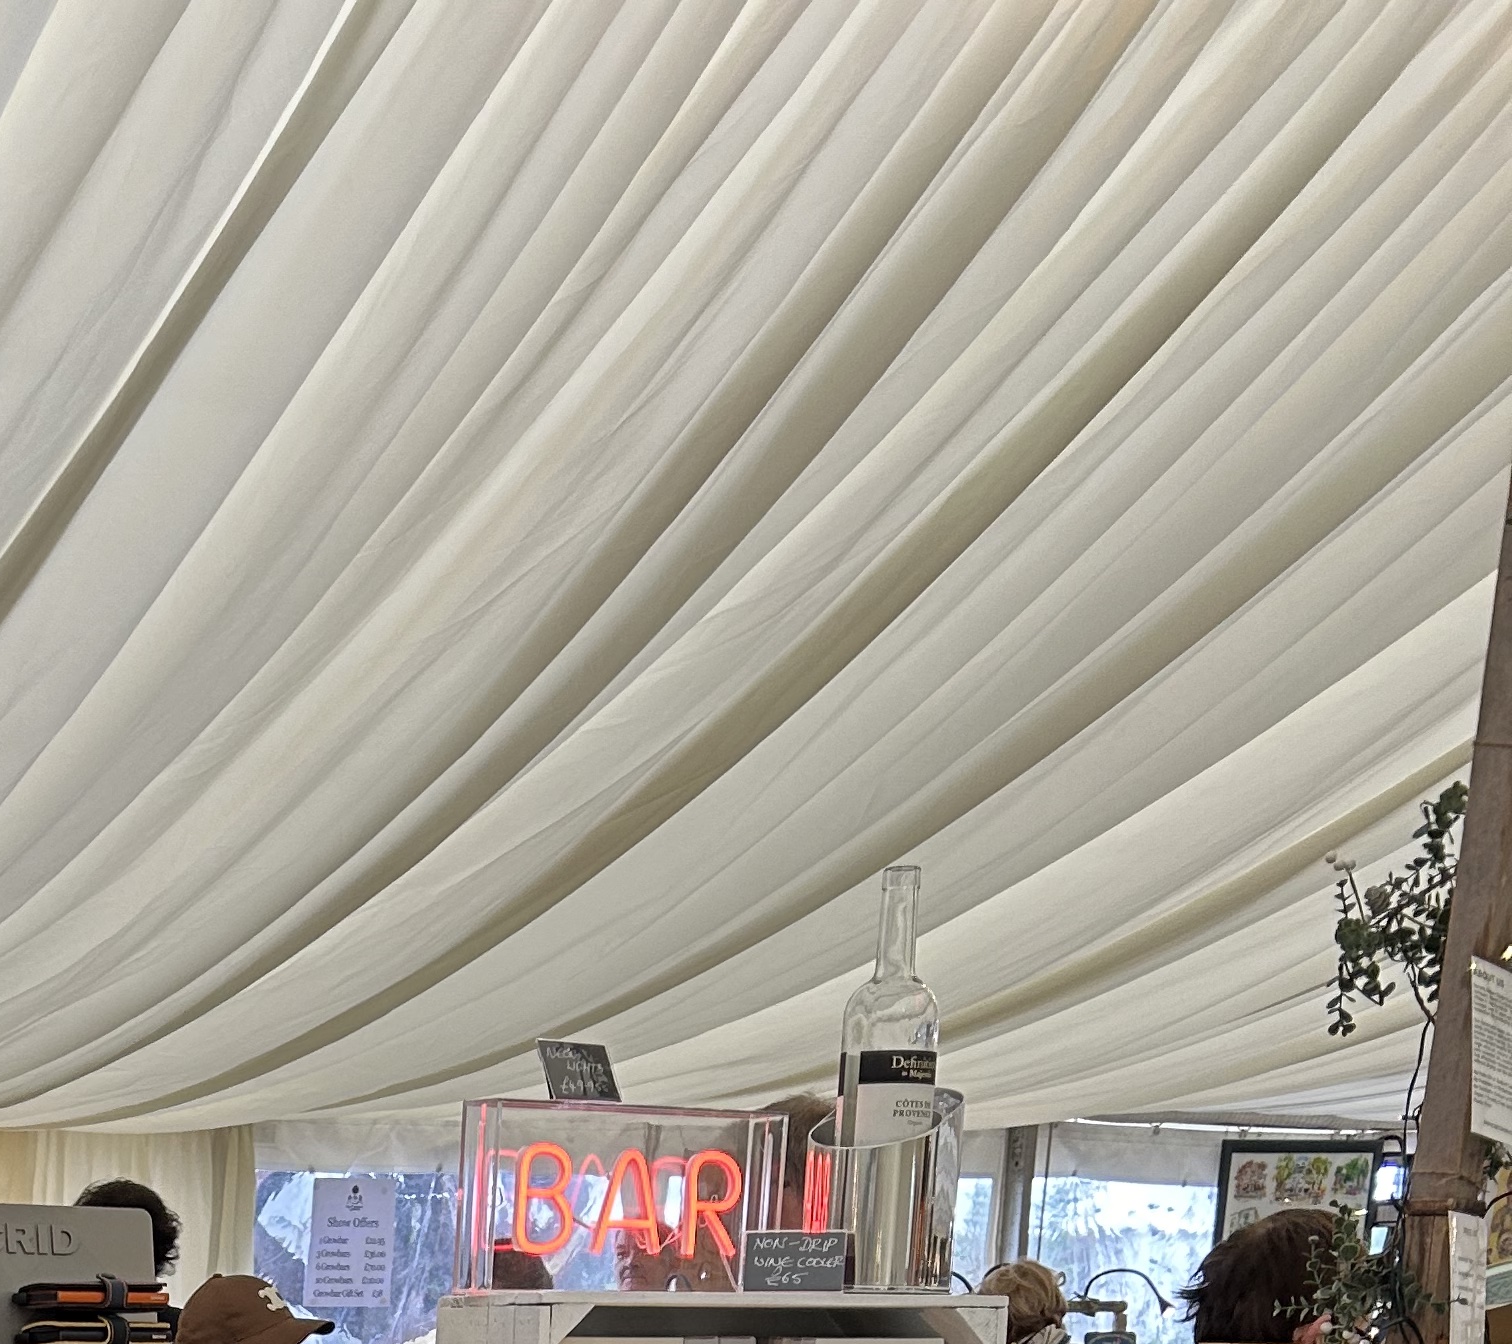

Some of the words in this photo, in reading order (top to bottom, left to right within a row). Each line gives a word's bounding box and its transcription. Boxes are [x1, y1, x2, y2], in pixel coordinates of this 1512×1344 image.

[514, 1141, 744, 1257] BAR
[353, 1217, 379, 1228] Offers
[754, 1256, 795, 1268] WINE
[797, 1255, 845, 1268] COOLER
[765, 1265, 809, 1286] £65
